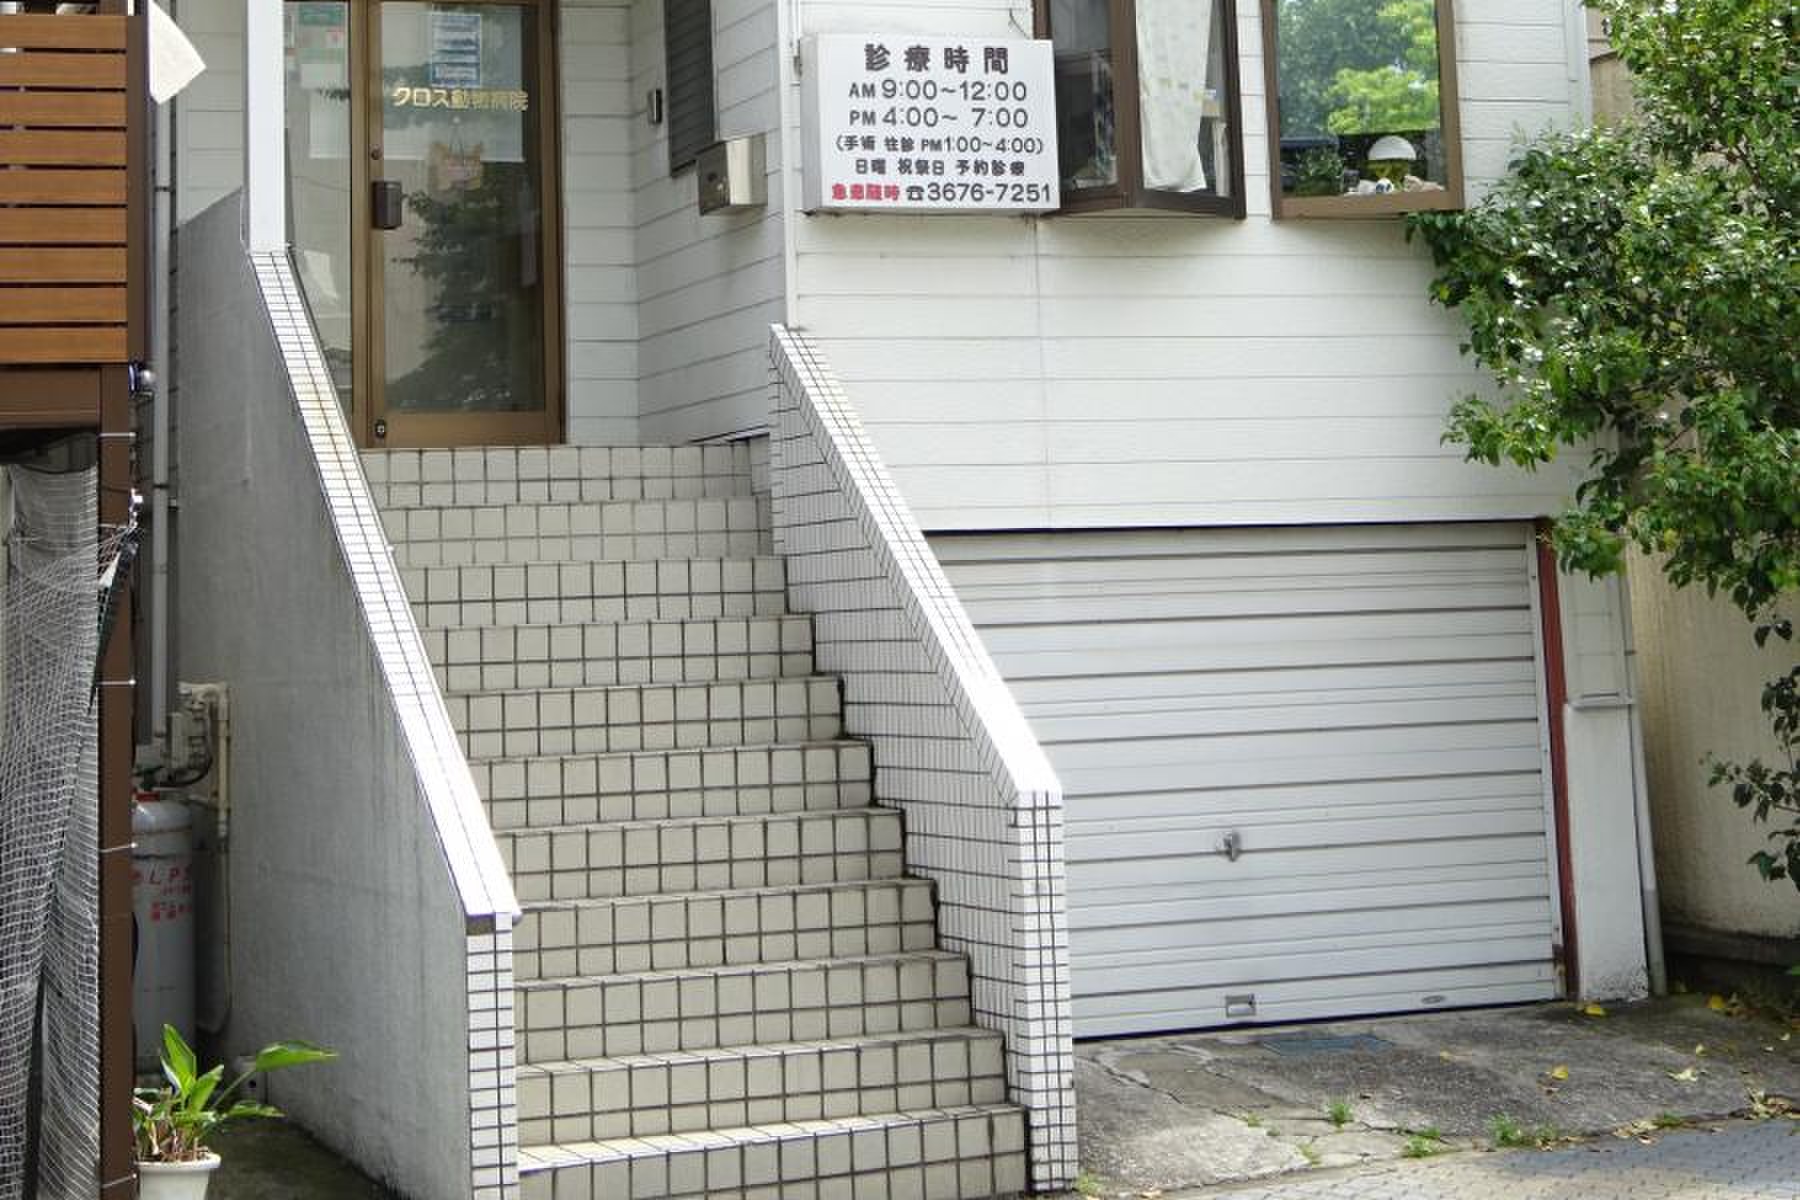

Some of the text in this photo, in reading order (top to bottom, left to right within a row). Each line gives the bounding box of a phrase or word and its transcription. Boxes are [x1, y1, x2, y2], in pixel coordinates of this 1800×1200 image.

[864, 43, 1009, 75] 診療時間
[849, 82, 876, 99] AM
[850, 109, 876, 126] PM
[855, 158, 1025, 177] 日曜 祝祭日 予約診療
